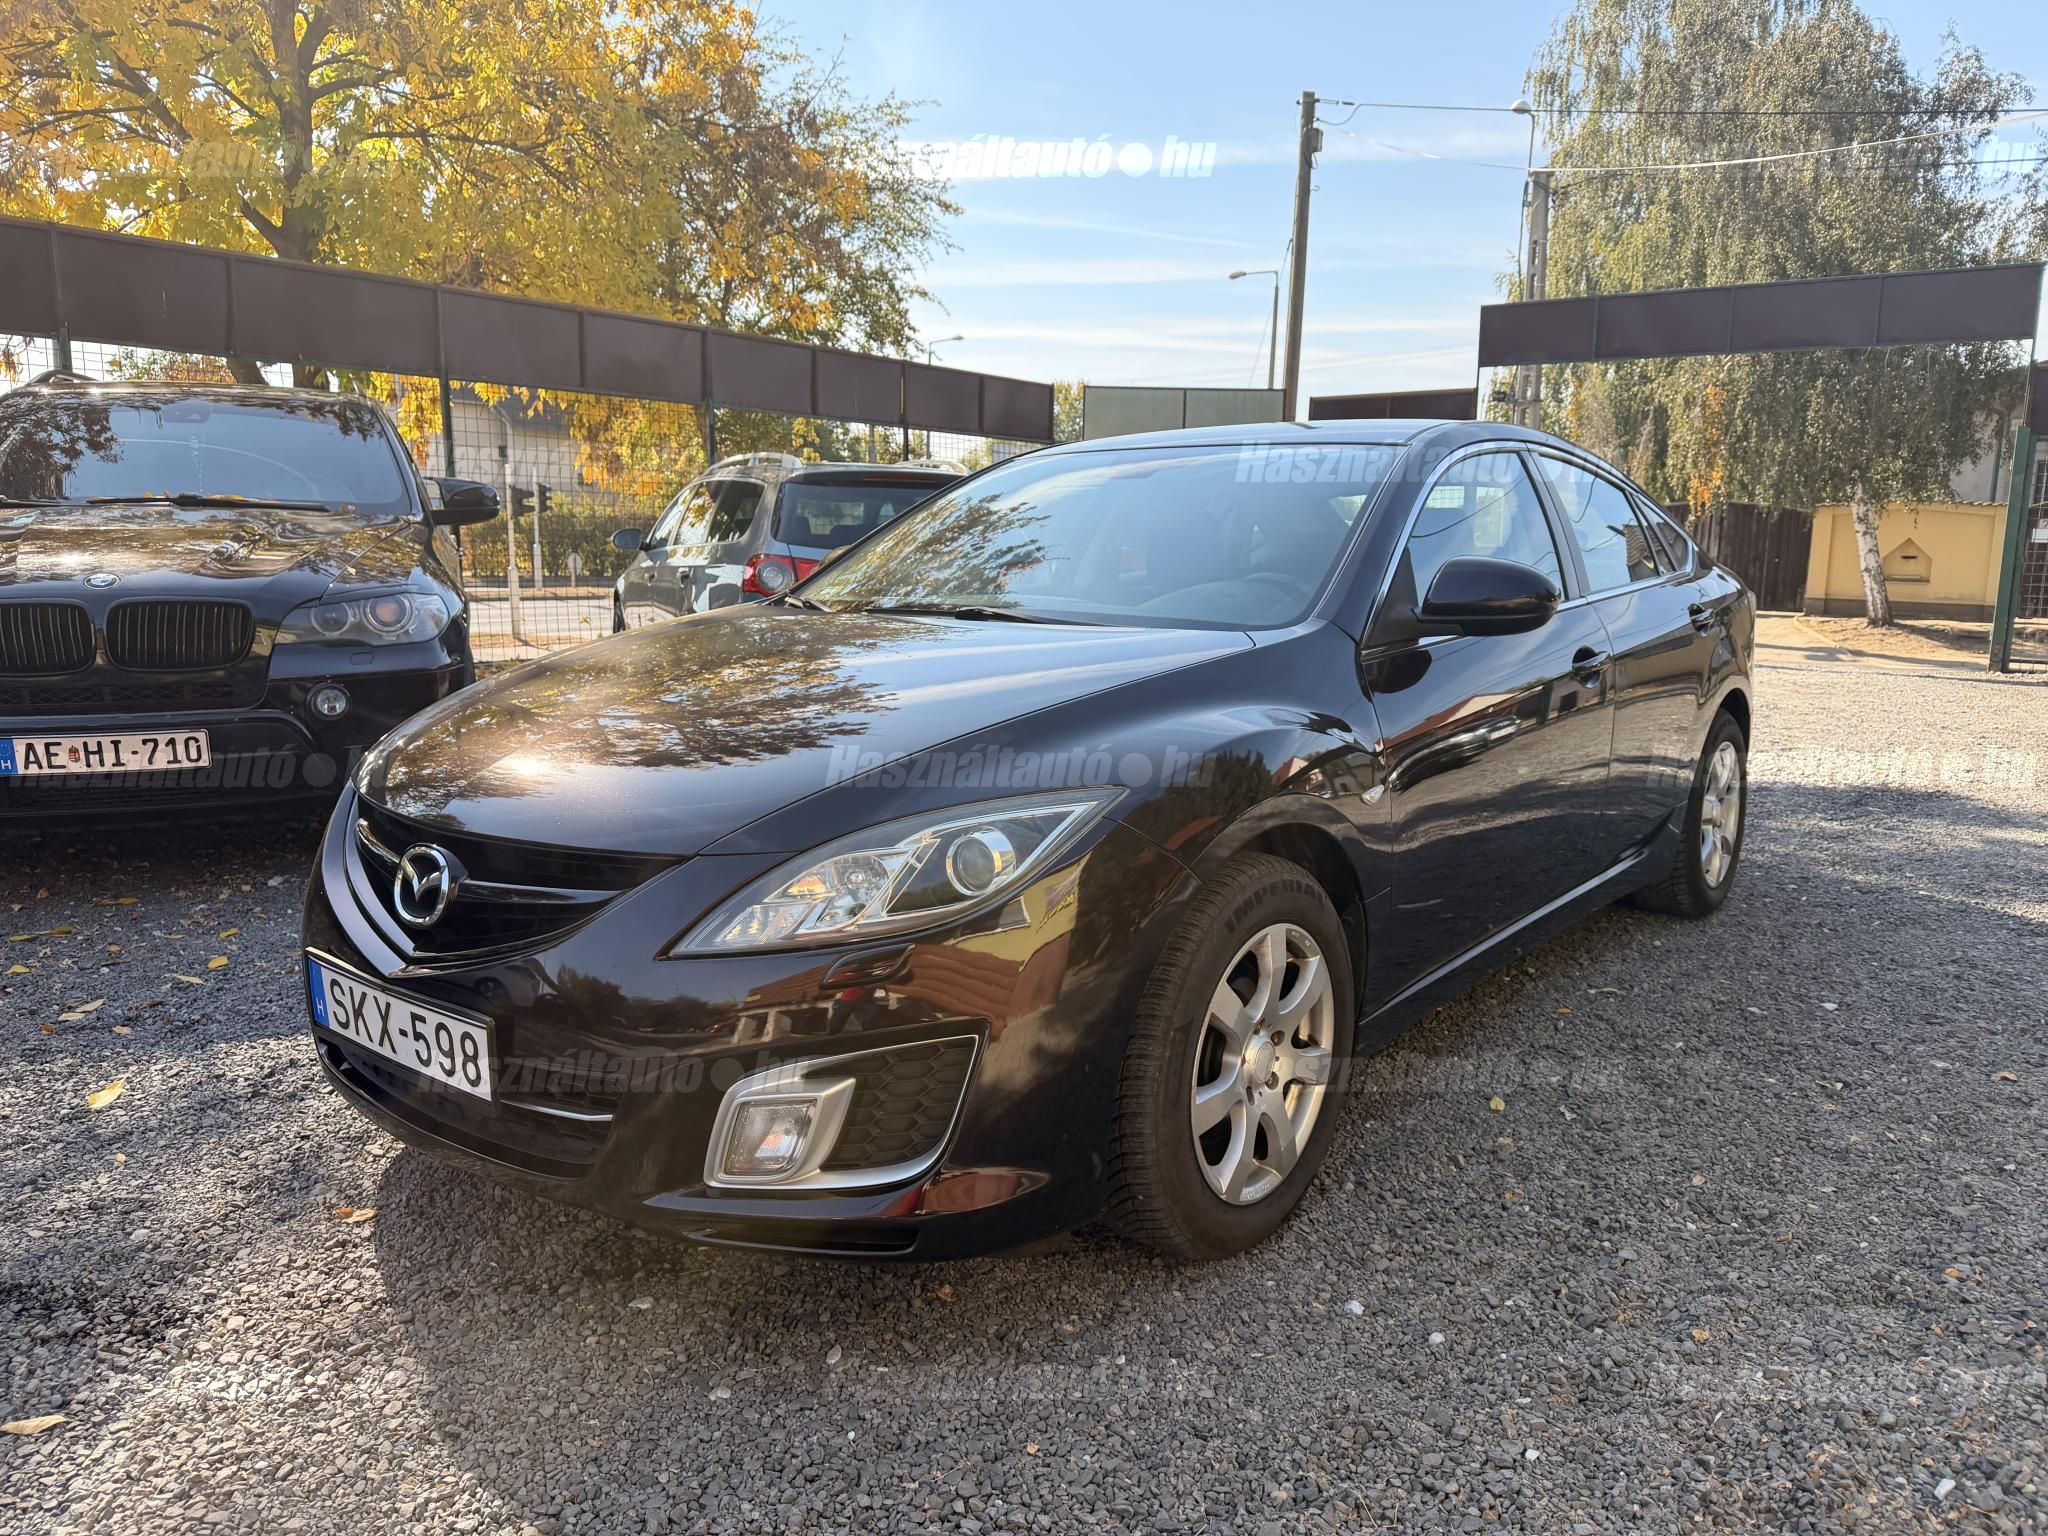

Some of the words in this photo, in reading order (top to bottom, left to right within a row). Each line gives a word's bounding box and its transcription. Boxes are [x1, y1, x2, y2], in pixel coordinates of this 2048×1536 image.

[23, 742, 67, 770] AE
[83, 736, 202, 768] HI-710
[329, 978, 482, 1088] SKX-598
